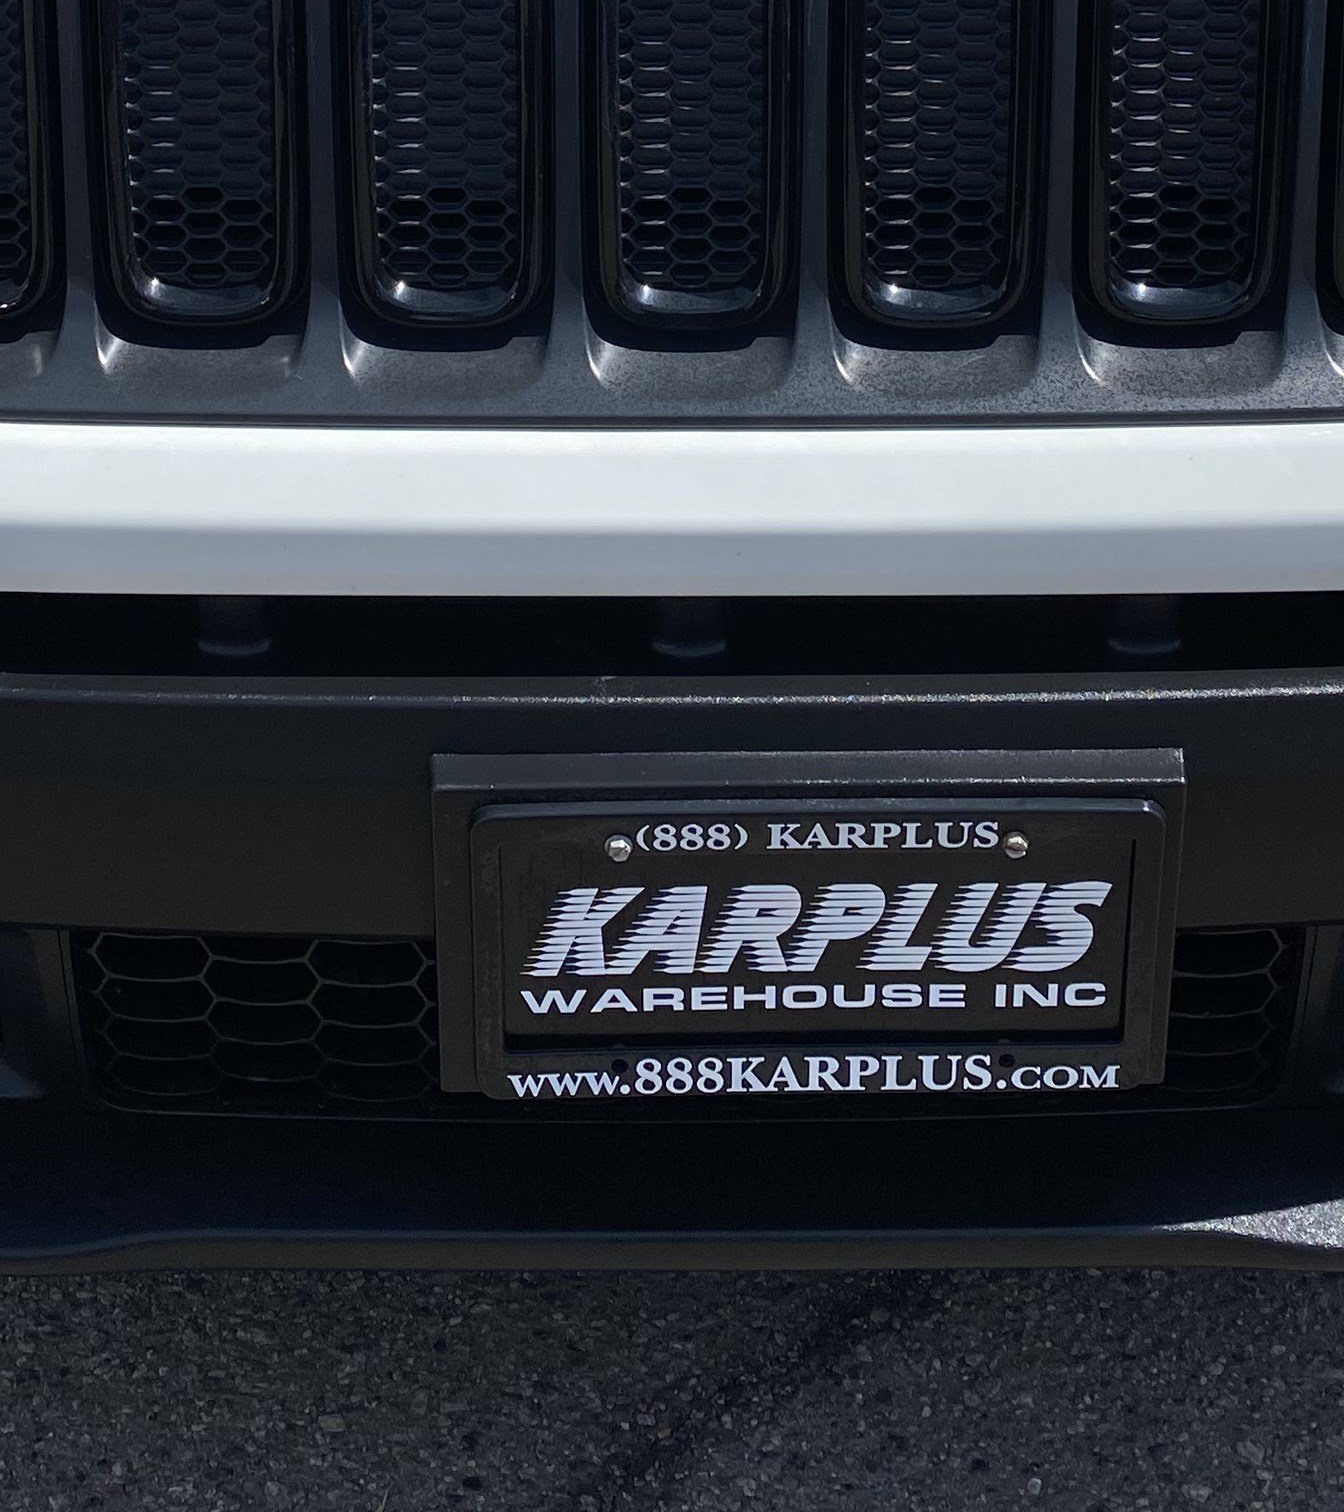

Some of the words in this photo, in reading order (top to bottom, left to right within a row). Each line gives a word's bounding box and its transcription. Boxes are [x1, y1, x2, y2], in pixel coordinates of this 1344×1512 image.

[635, 823, 749, 851] (888)
[766, 821, 999, 850] KARPLUS
[518, 881, 1113, 977] KARPLUS
[520, 983, 967, 1014] WAREHOUSE
[994, 983, 1107, 1008] INC
